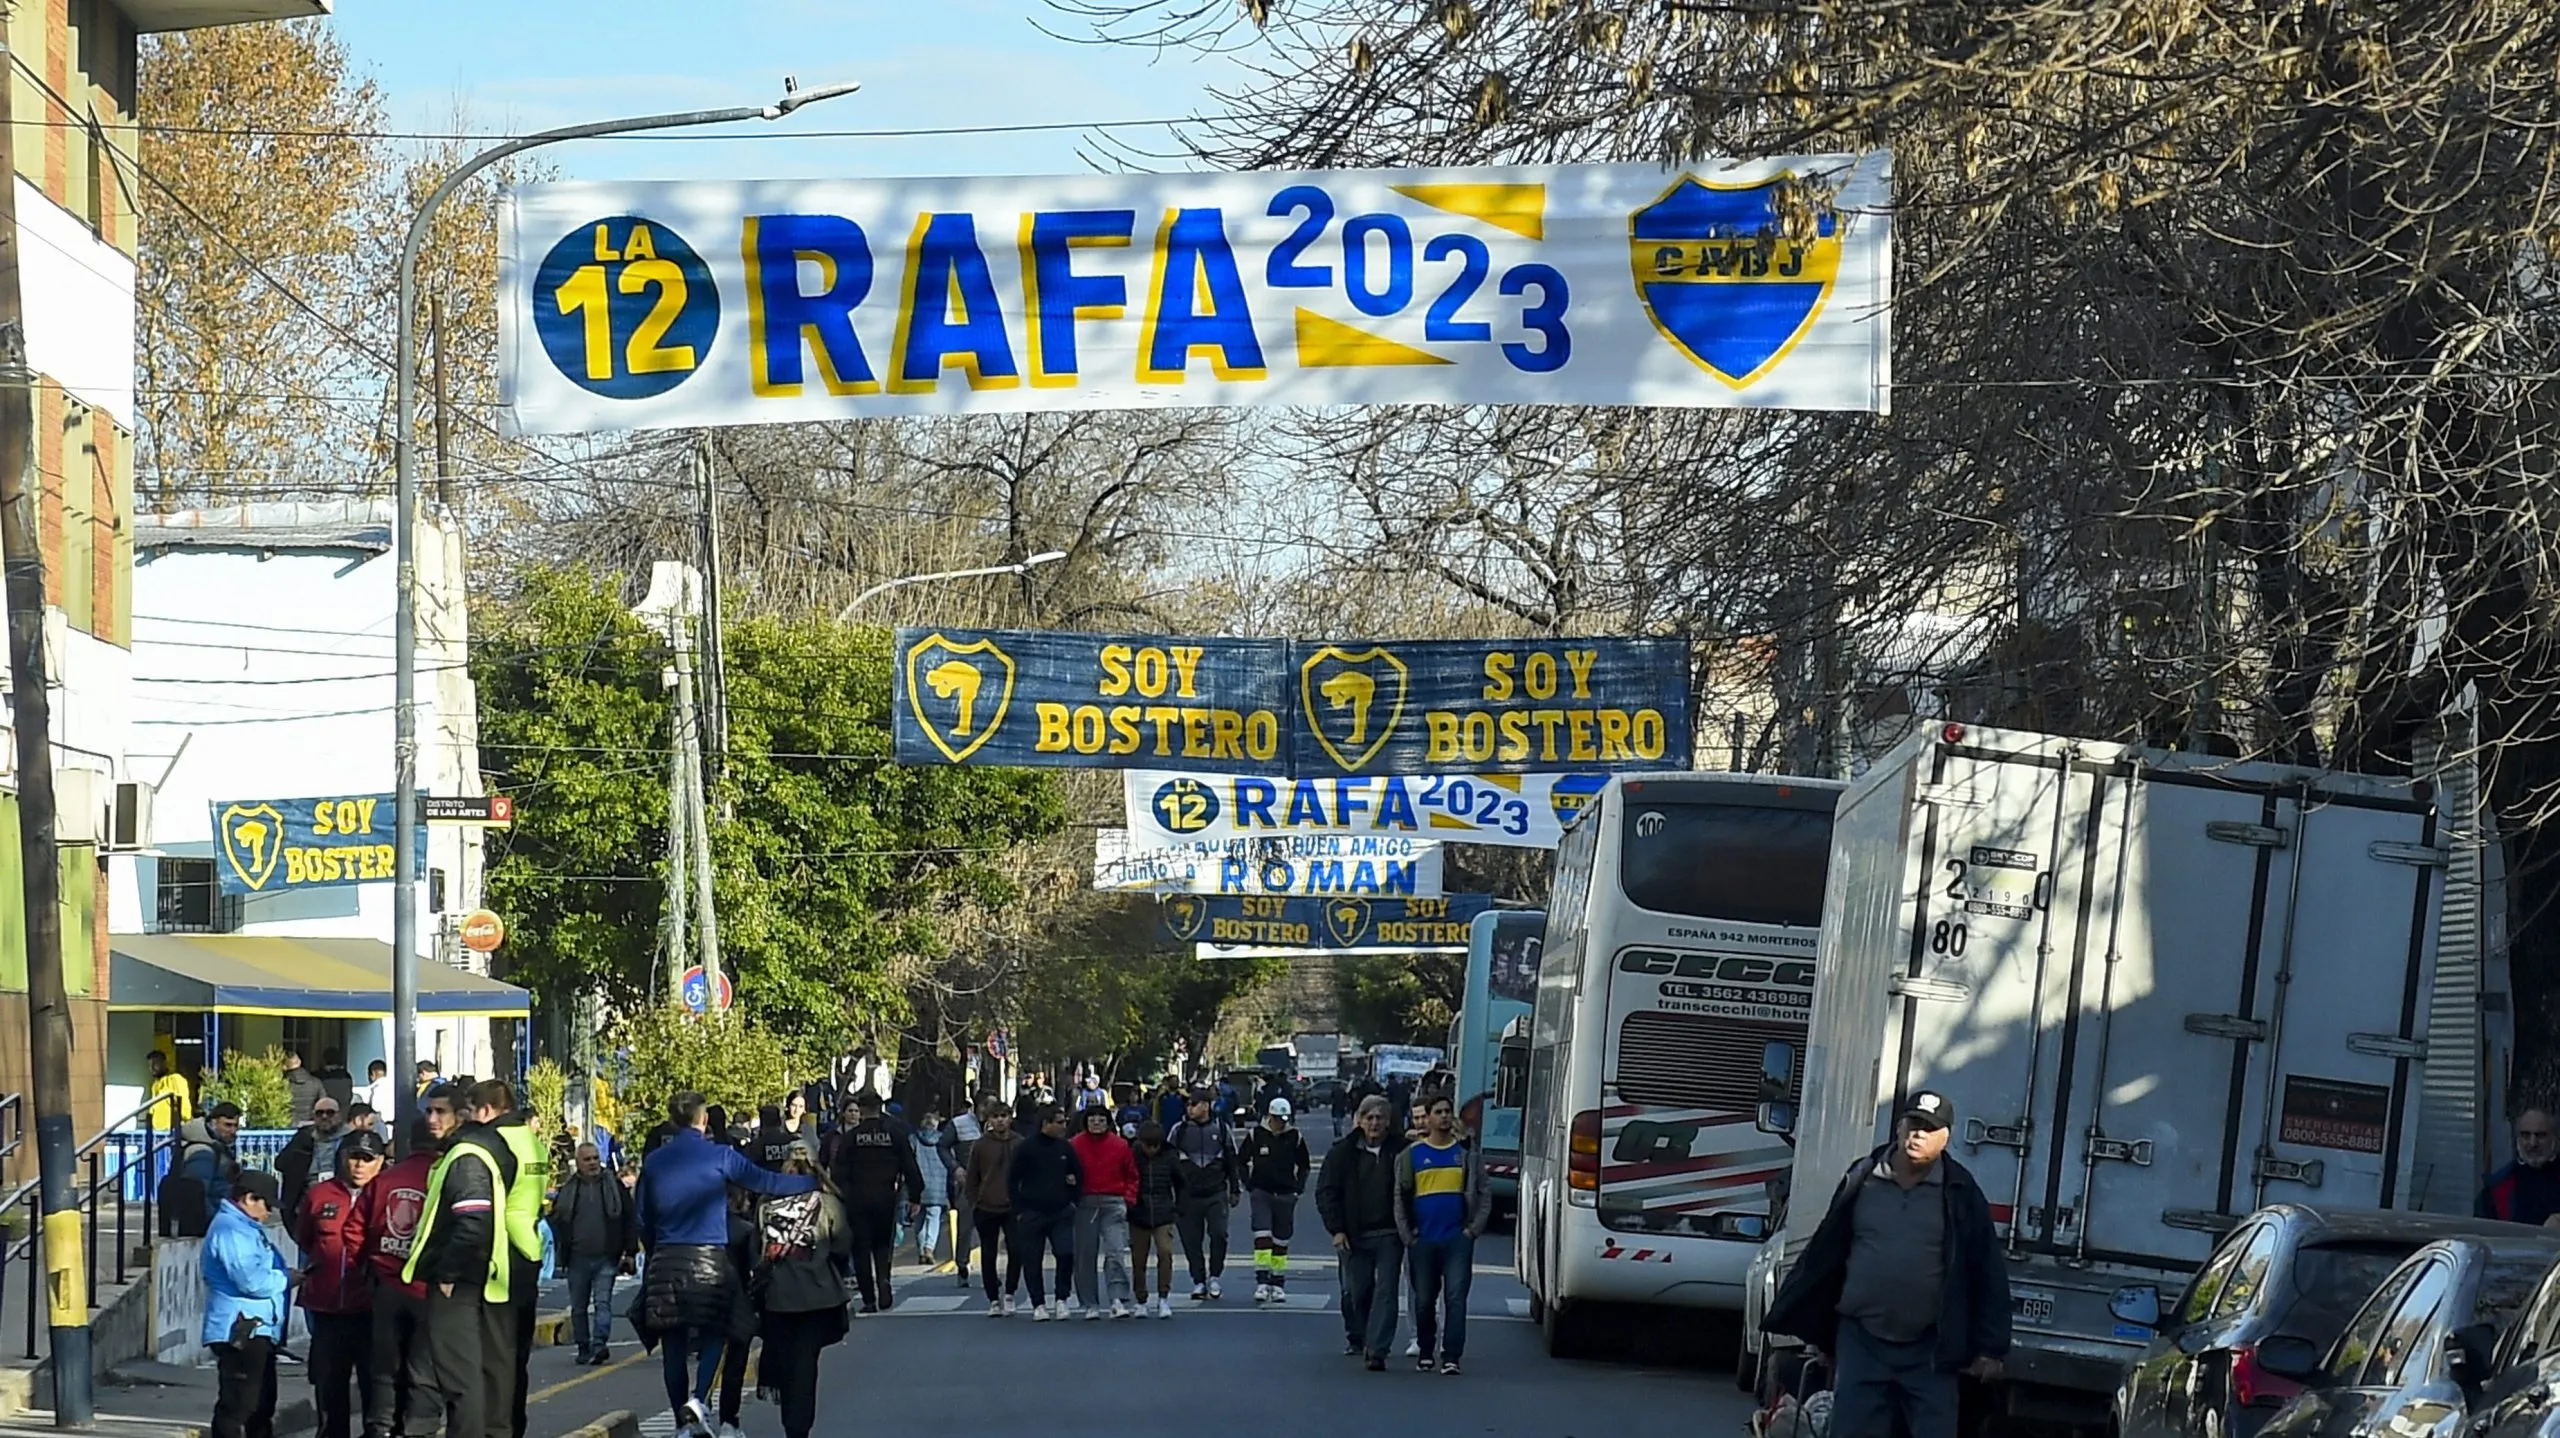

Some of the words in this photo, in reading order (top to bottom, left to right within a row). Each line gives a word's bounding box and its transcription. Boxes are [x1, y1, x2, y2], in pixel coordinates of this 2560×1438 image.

[594, 224, 653, 261] LA
[1655, 246, 1805, 276] CABJ
[741, 207, 1267, 397] RAFA
[1266, 185, 1572, 373] 2023
[555, 259, 697, 380] 12
[1100, 644, 1204, 698] SOY
[1483, 649, 1598, 700] SOY
[1035, 703, 1277, 761] BOSTERO
[1425, 708, 1665, 763] BOSTERO
[1174, 780, 1199, 792] LA
[313, 799, 376, 836] SOY
[427, 800, 465, 808] DISTRITO
[459, 809, 486, 817] ARTES
[1160, 794, 1207, 829] 12
[1230, 776, 1419, 831] RAFA
[1419, 775, 1529, 835] 2023
[1292, 836, 1340, 856] BUEN
[284, 844, 395, 884] BOSTER
[1219, 858, 1416, 894] ROMAN
[1242, 897, 1286, 917] SOY
[1406, 897, 1448, 917] SOY
[1212, 918, 1310, 944] BOSTERO
[1668, 927, 1717, 940] ESPAÑA
[1720, 932, 1744, 942] 942
[1747, 935, 1817, 948] MORTEROS
[1932, 920, 1968, 957] 80
[1620, 951, 1816, 987] CECC
[1665, 983, 1697, 996] TEL.
[1702, 986, 1743, 1000] 3562
[1658, 999, 1811, 1021] transcecchi@hotm
[2285, 1116, 2382, 1138] EMERGENCIAS
[2023, 1299, 2051, 1319] 689
